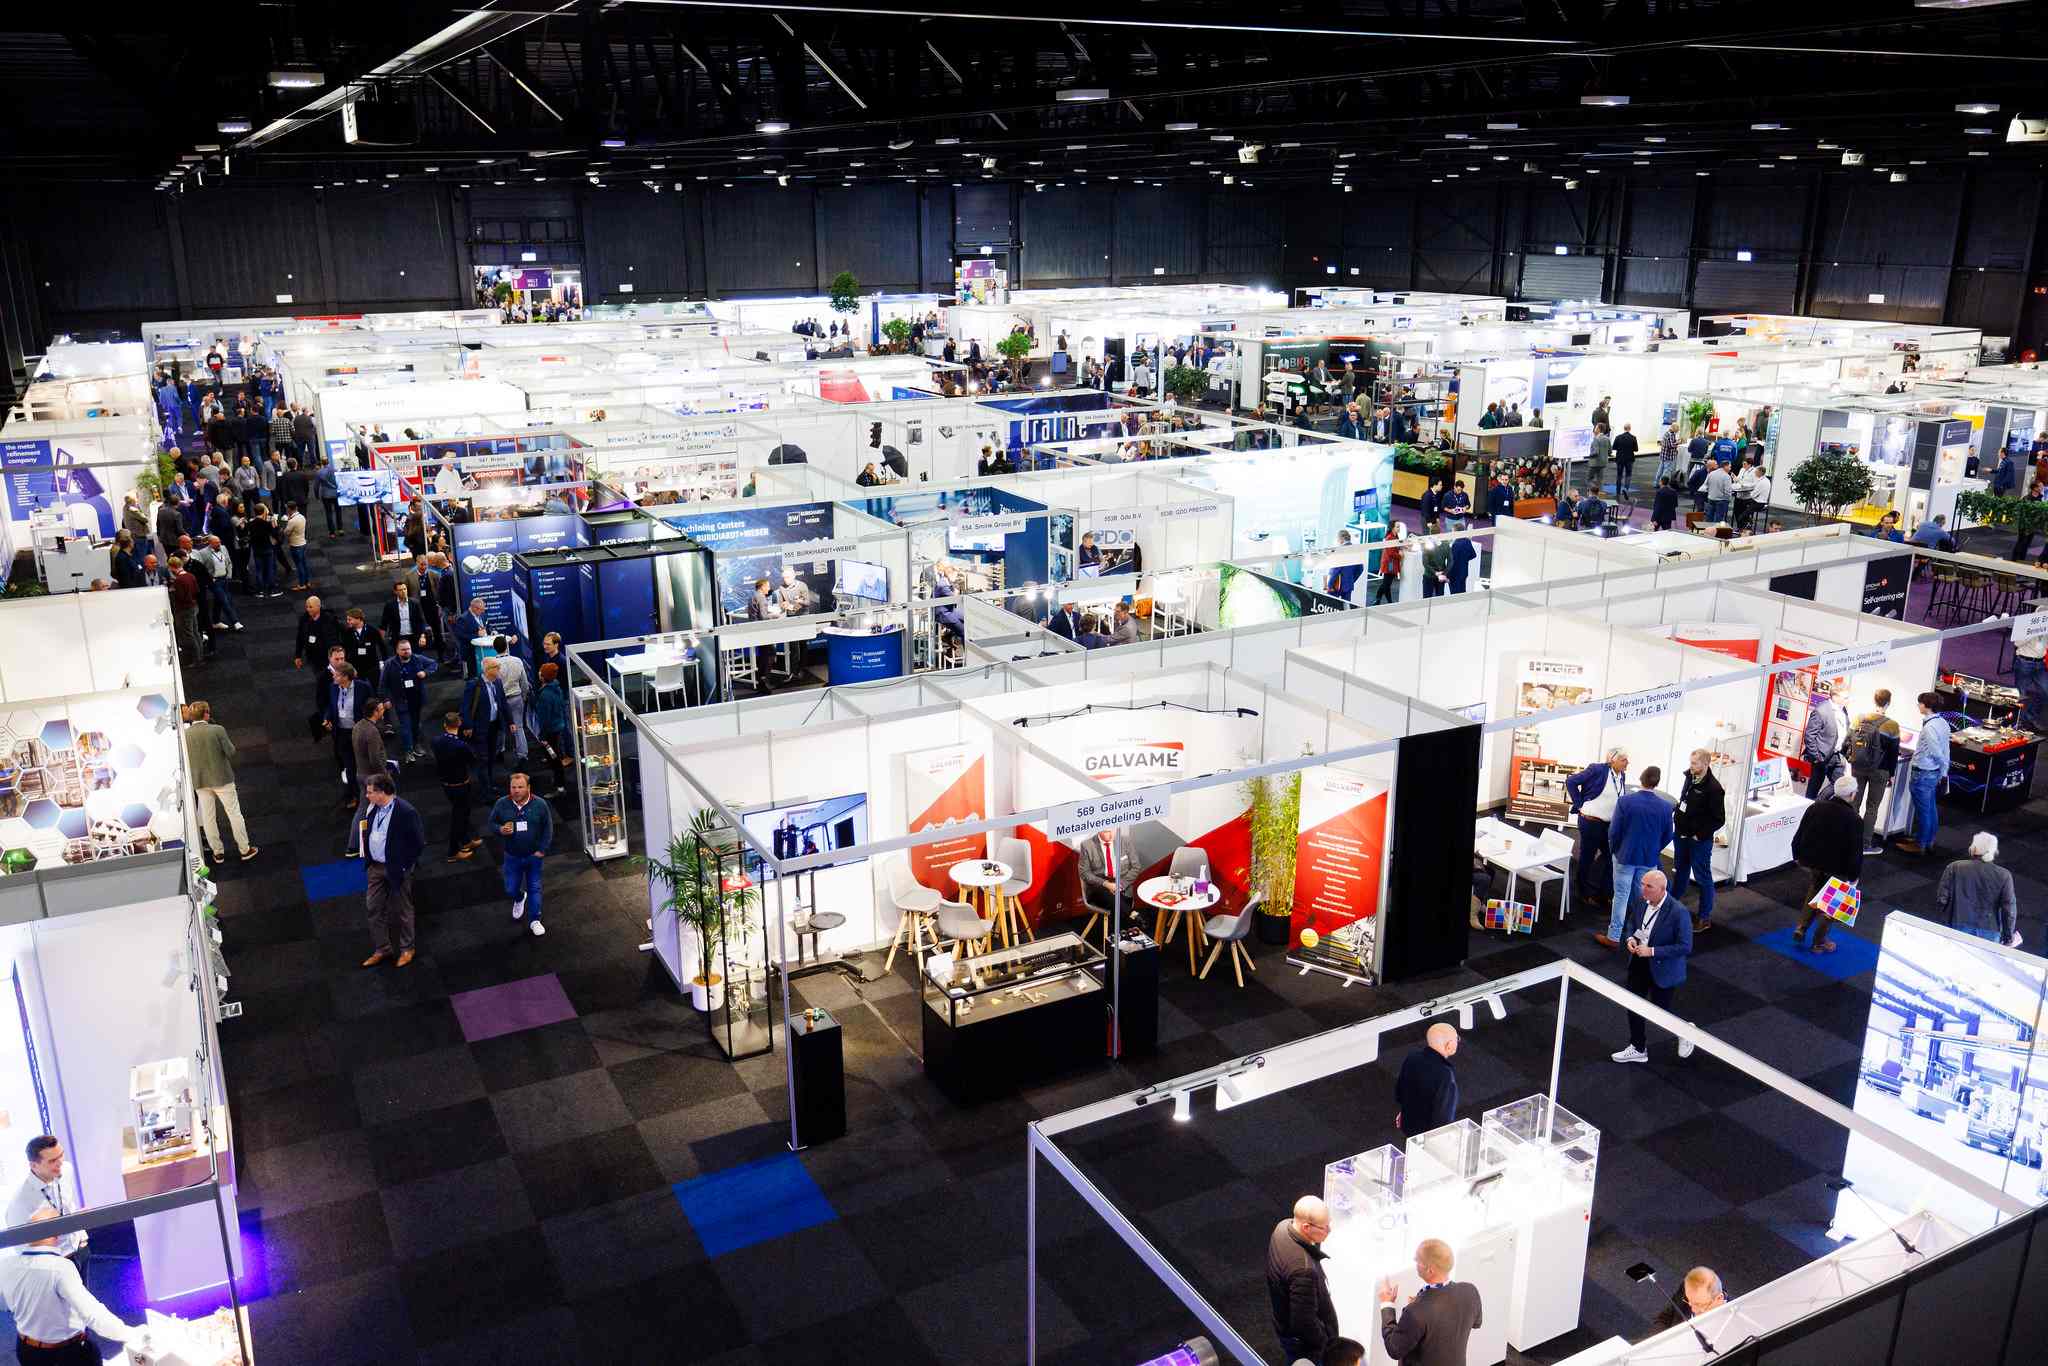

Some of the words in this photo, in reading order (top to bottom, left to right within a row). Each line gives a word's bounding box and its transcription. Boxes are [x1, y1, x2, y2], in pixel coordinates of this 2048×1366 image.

[716, 520, 745, 530] Centers
[1603, 702, 1617, 712] 568
[1619, 698, 1644, 709] Horstra
[1646, 690, 1683, 703] Technology
[1616, 712, 1630, 721] B.V.
[1085, 751, 1179, 771] GALVAMÉ
[1076, 805, 1095, 818] 569
[1100, 796, 1144, 813] Galvamé
[1056, 811, 1142, 836] Metaalveredeling
[1143, 805, 1163, 818] B.V.
